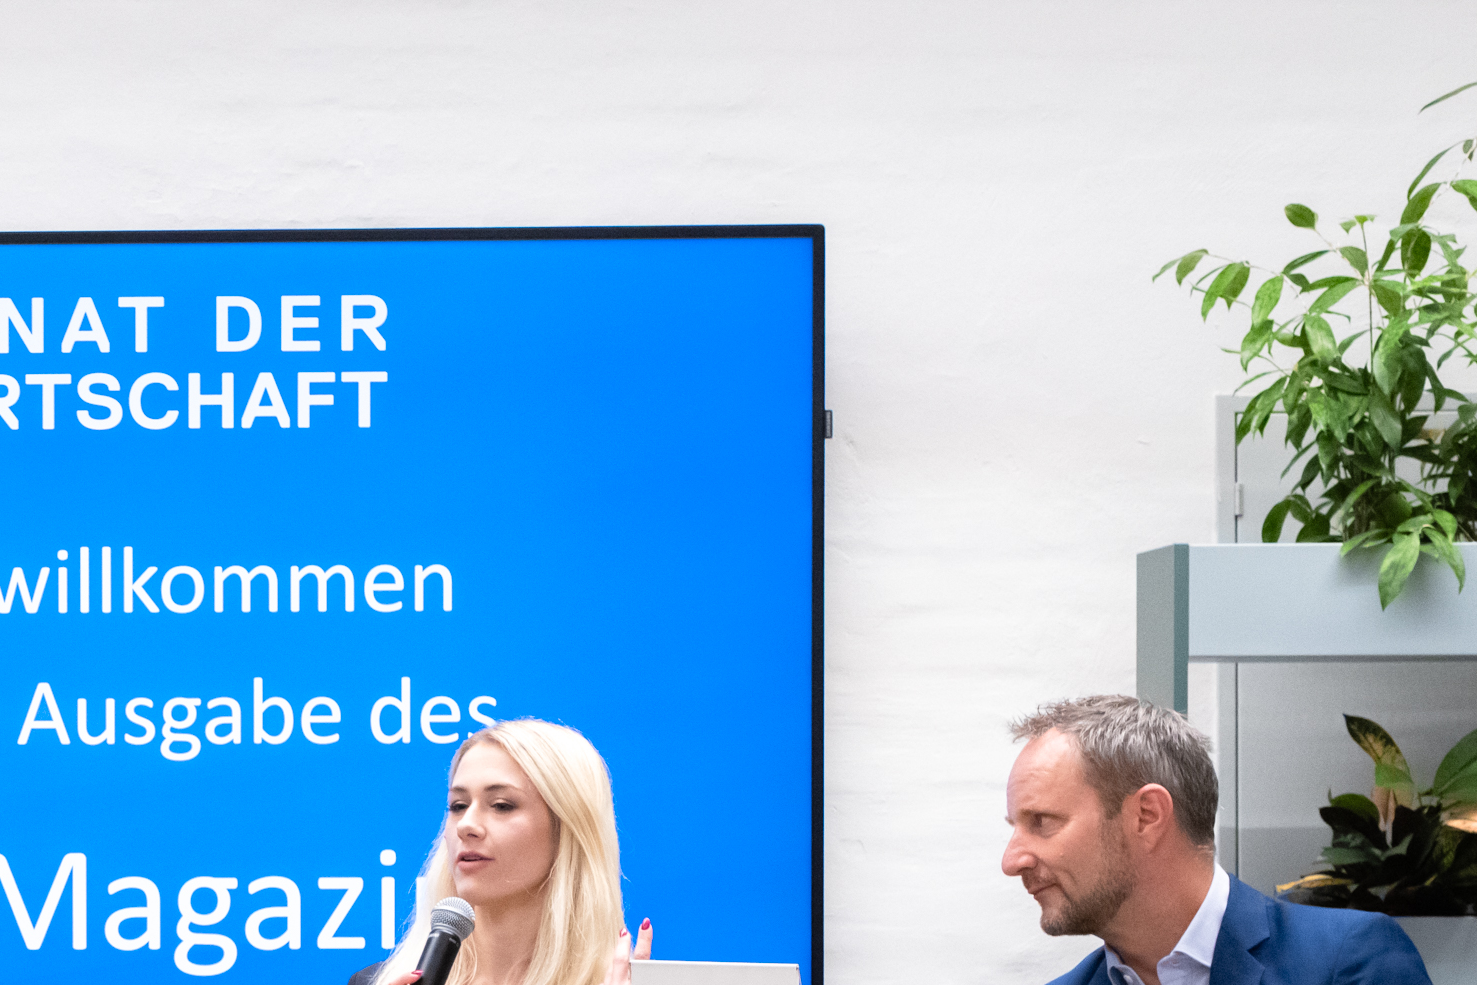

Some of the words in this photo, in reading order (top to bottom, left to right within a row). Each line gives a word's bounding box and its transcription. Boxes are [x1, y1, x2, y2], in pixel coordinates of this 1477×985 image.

[215, 294, 388, 353] DER
[16, 677, 342, 762] Ausgabe
[370, 676, 498, 745] des
